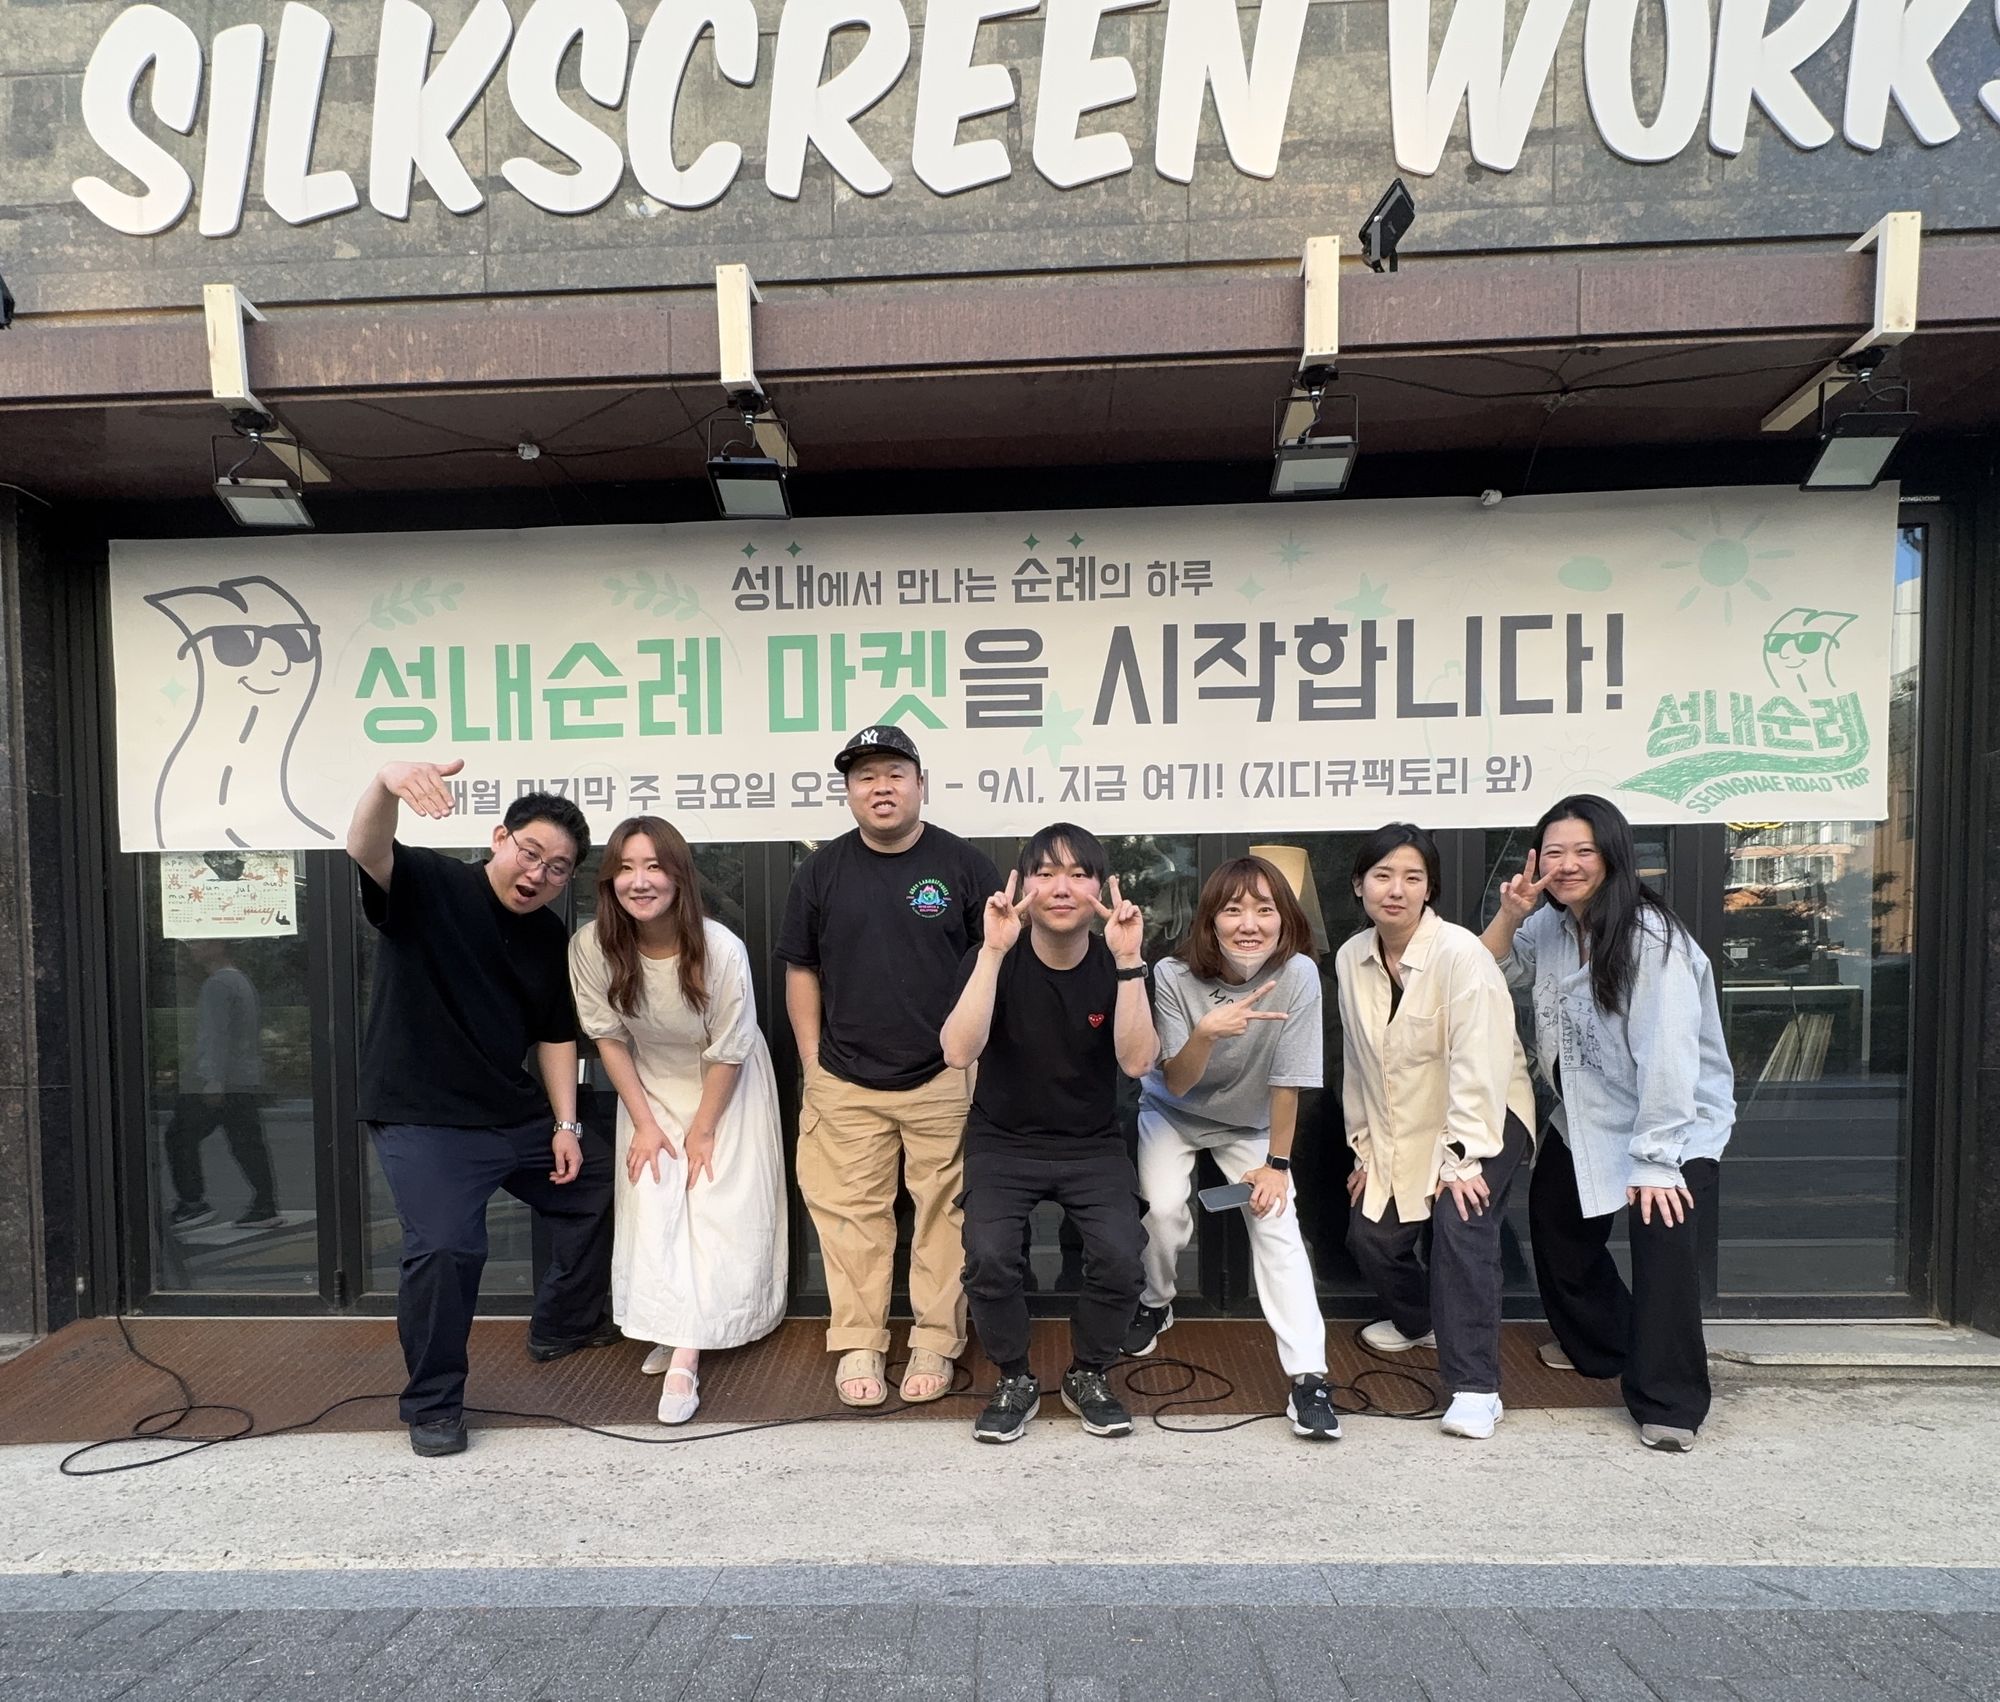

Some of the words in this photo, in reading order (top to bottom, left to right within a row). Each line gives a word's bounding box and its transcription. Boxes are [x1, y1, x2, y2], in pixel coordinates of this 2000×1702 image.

[72, 0, 1308, 237] SILKSCREEN
[1388, 0, 2000, 175] WORK
[731, 564, 882, 612] 성내에서
[897, 567, 997, 605] 만나는
[1011, 556, 1131, 603] 순례의
[1147, 560, 1214, 598] 하루
[355, 636, 724, 744] 성내순례
[767, 627, 1049, 732] 마켓을
[1092, 613, 1624, 726] 시작합니다!
[860, 729, 879, 745] NY
[1646, 688, 1871, 758] 성내순례
[629, 774, 662, 811] 주
[675, 772, 776, 809] 금요일
[978, 767, 1044, 804] 9시,
[1060, 764, 1127, 803] 지금
[1143, 762, 1224, 801] 여기!
[1240, 756, 1468, 799] (지디큐팩토리
[1485, 755, 1533, 795] 앞)
[1686, 775, 1783, 815] SEONGNAE
[1787, 775, 1832, 793] ROAD
[1833, 767, 1870, 789] TRIP
